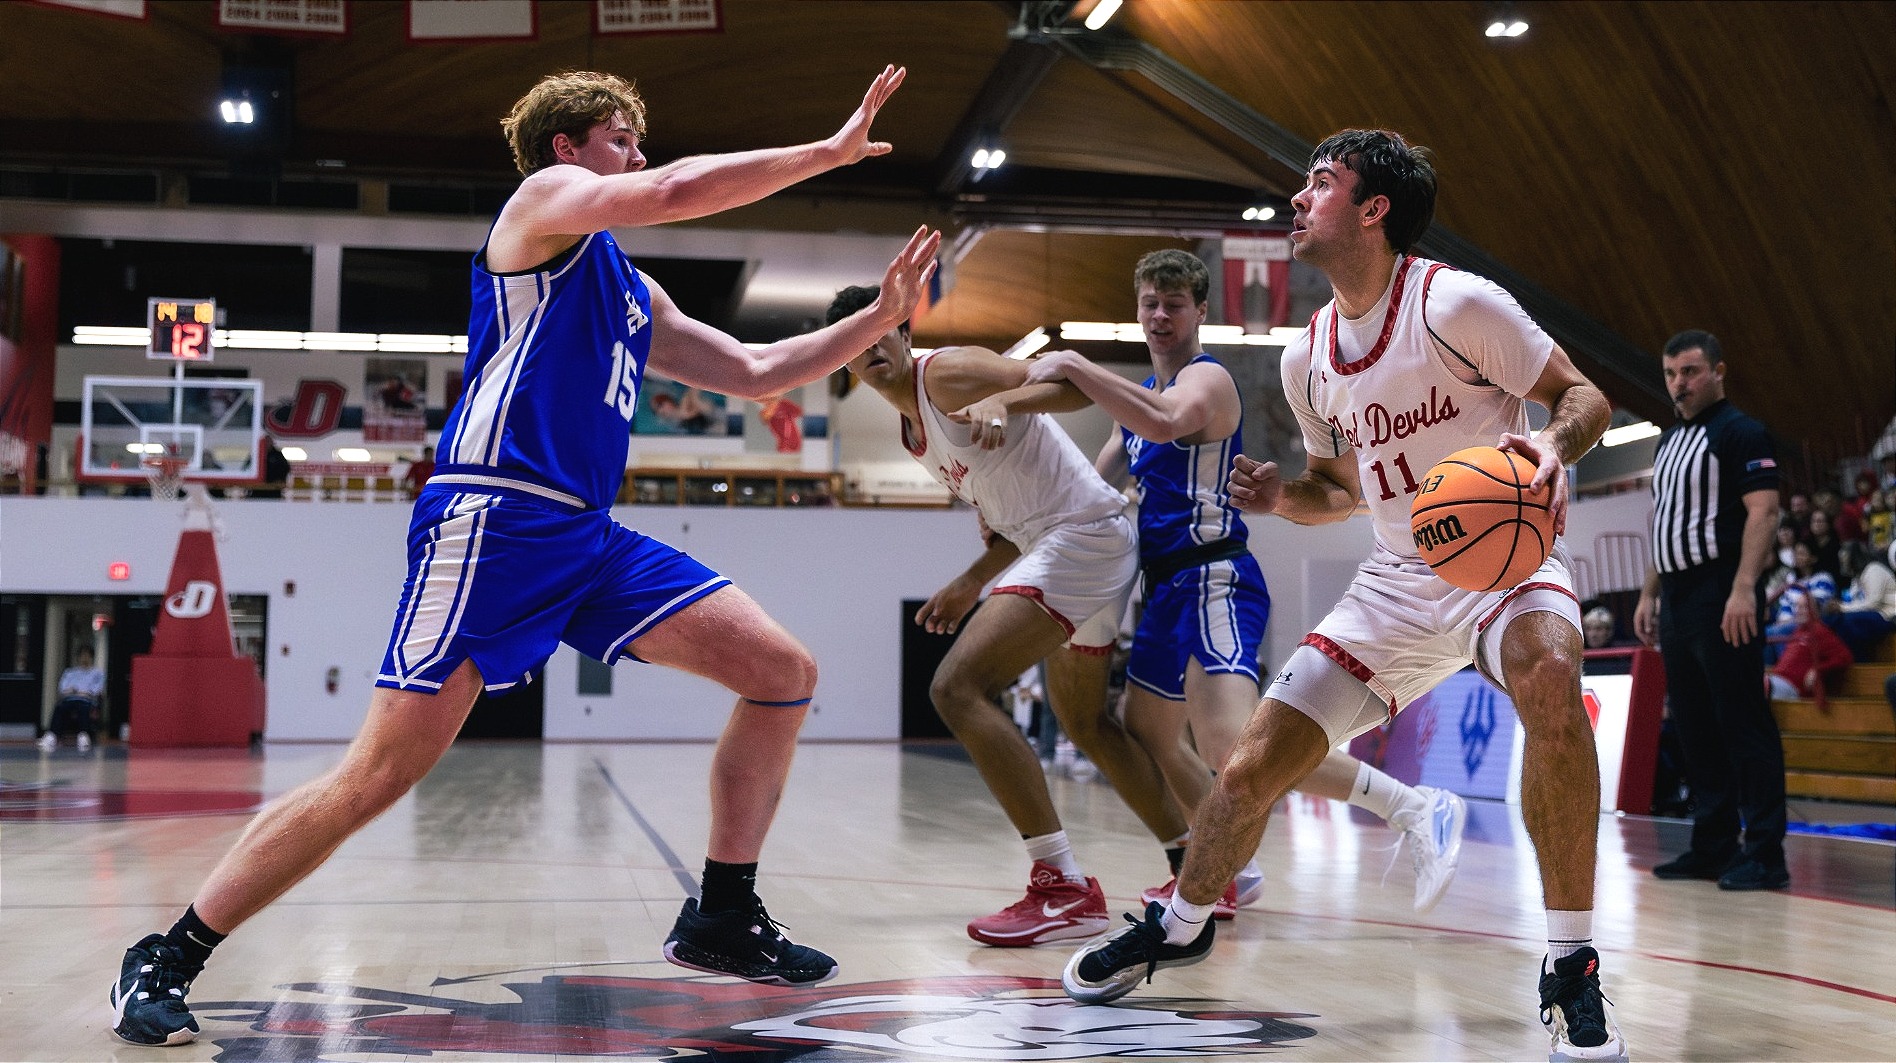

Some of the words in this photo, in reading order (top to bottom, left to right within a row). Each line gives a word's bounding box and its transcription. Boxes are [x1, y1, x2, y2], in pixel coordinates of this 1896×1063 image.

[172, 323, 204, 358] 12
[603, 339, 638, 423] 15
[1364, 385, 1461, 448] Devils
[1370, 451, 1420, 501] 11
